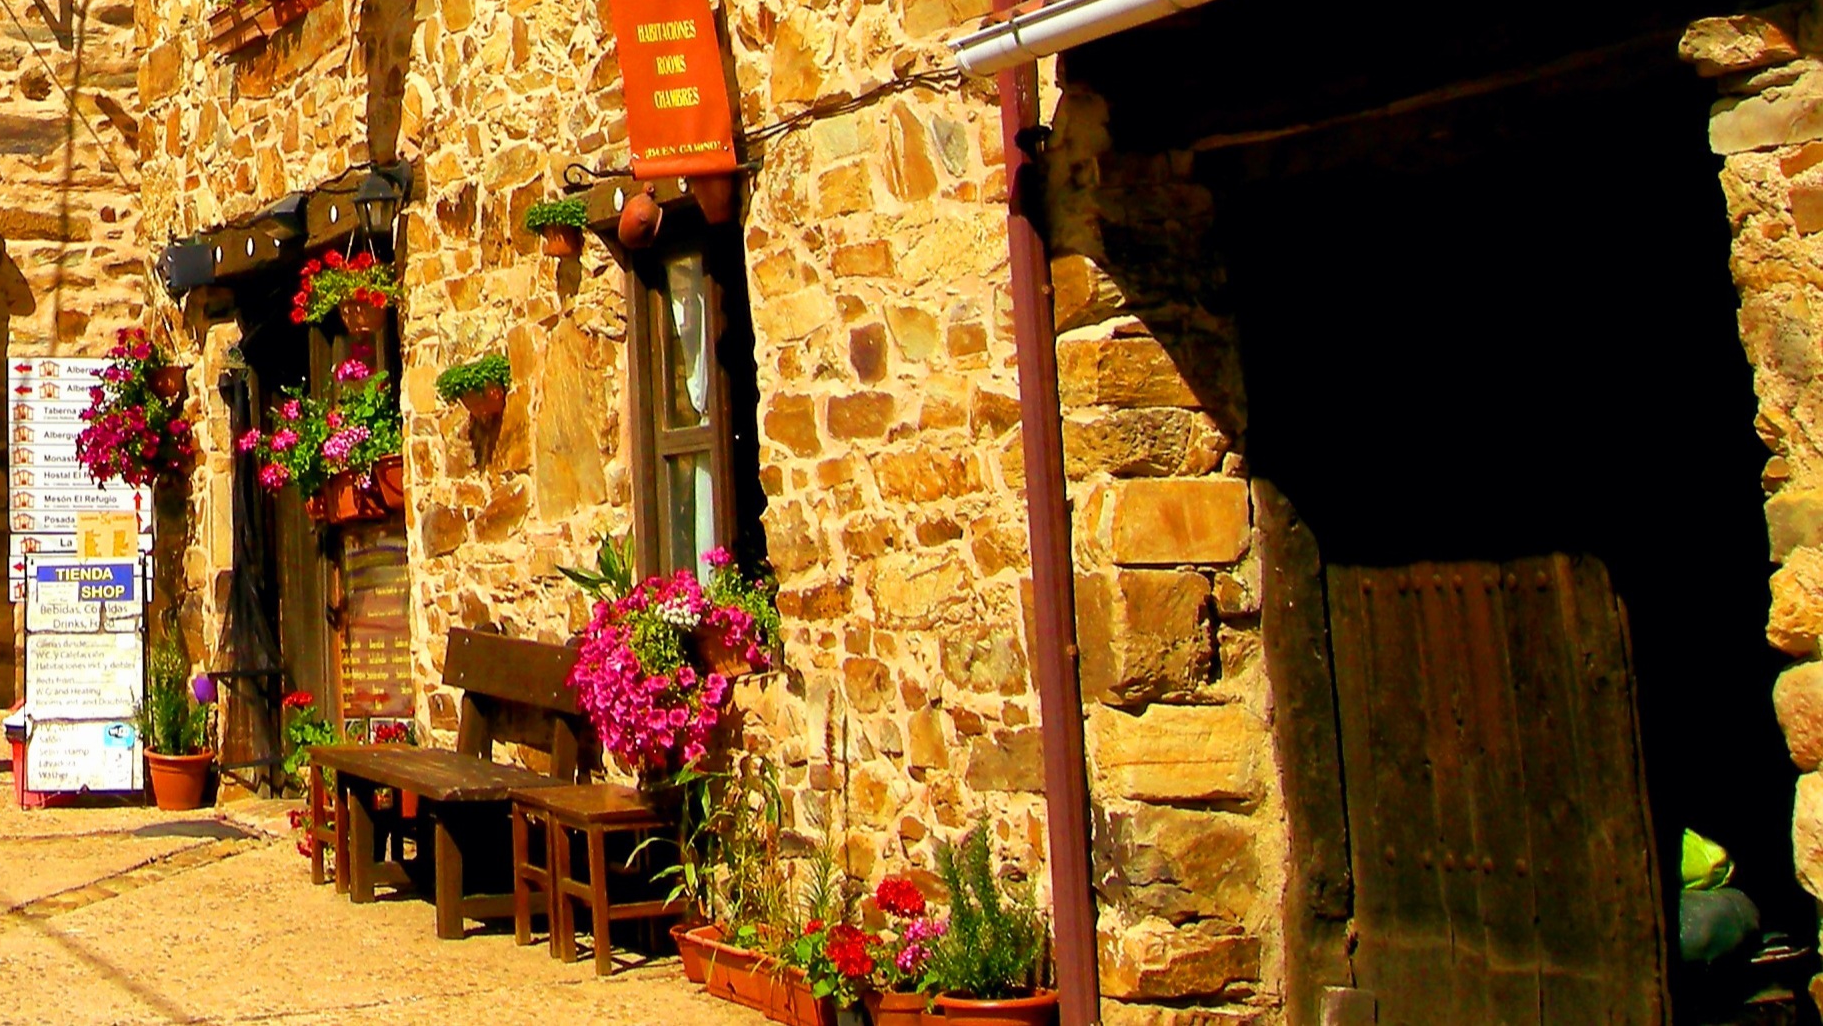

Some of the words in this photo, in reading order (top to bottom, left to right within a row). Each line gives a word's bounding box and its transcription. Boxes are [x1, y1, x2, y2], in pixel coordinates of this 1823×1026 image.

[637, 19, 696, 43] HABITACIONES
[656, 54, 687, 75] ROOMS
[654, 86, 700, 109] CHAMBRES
[44, 406, 76, 414] Taberna
[44, 431, 77, 440] Albergu
[44, 471, 71, 479] Hostal
[44, 494, 72, 503] Mesón
[74, 495, 82, 503] El
[85, 494, 117, 504] Refugio
[44, 515, 75, 523] Posada
[60, 537, 73, 547] La
[55, 567, 113, 580] TIENDA
[81, 585, 125, 598] SHOP
[84, 604, 128, 614] Coidas
